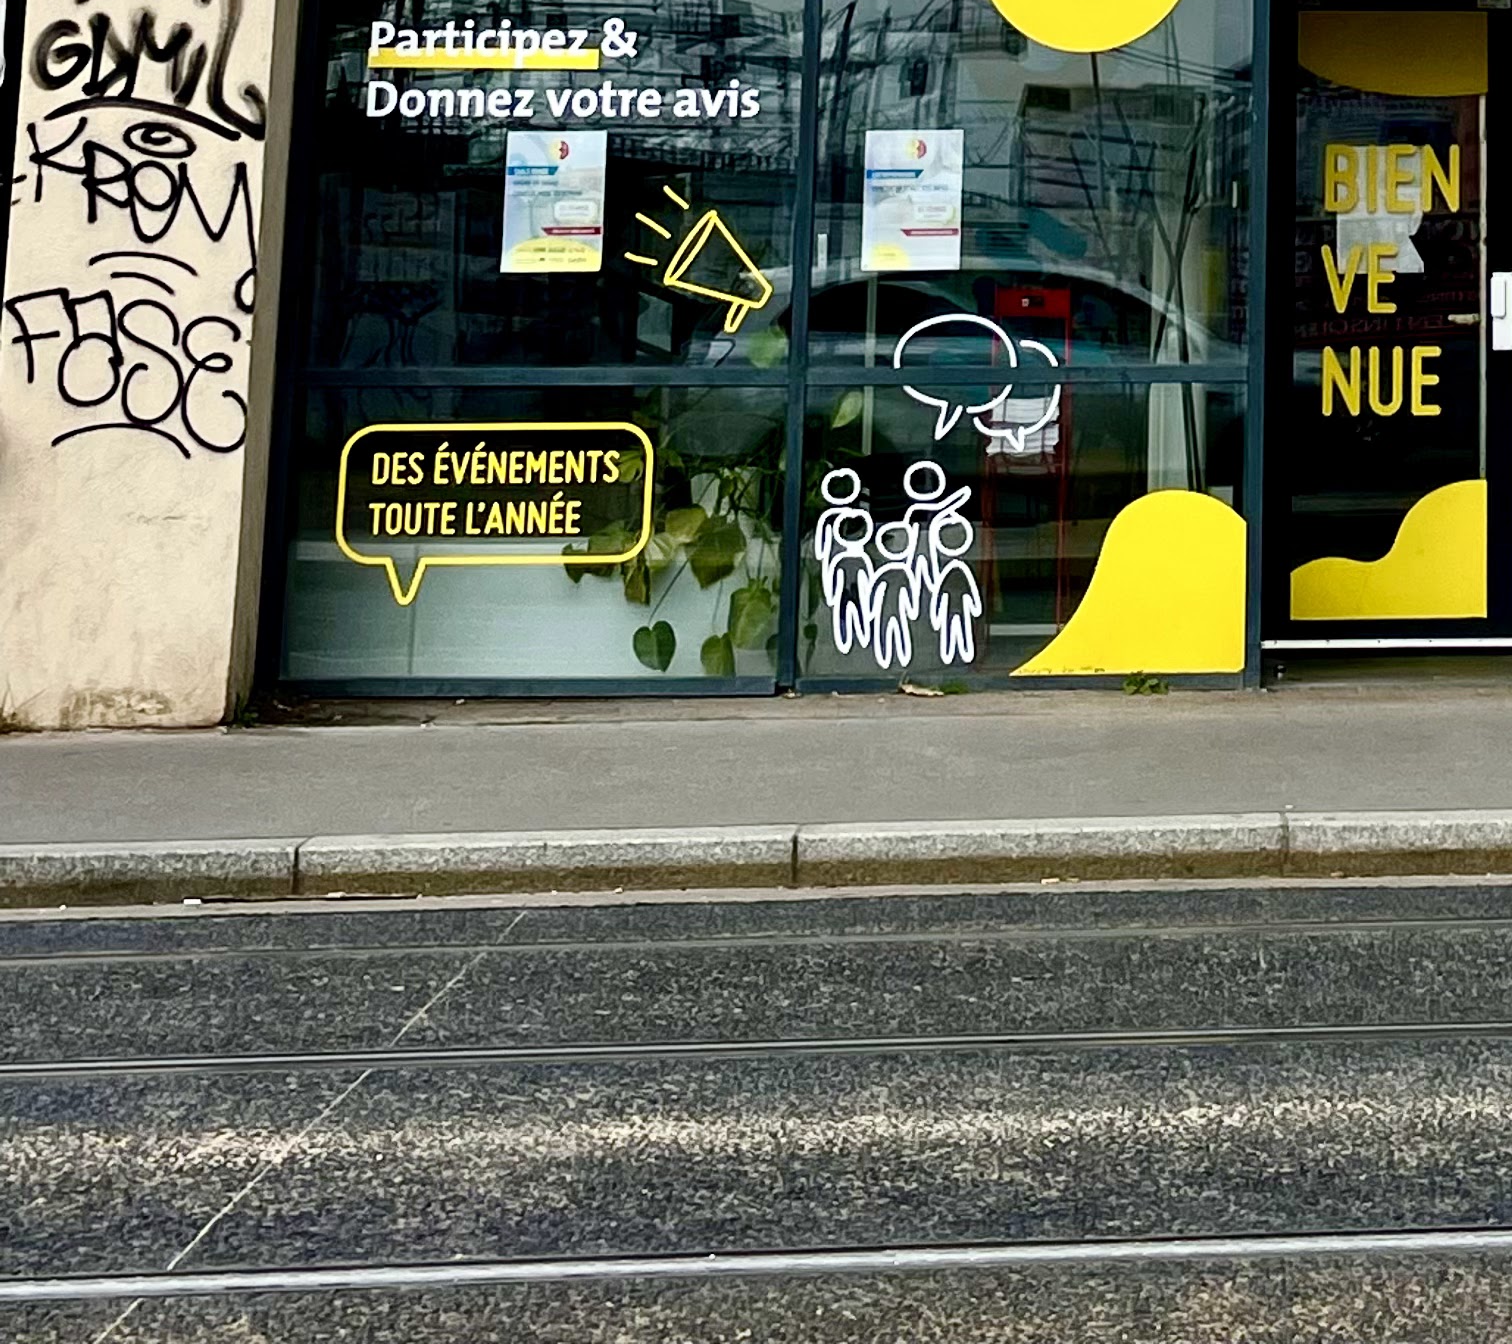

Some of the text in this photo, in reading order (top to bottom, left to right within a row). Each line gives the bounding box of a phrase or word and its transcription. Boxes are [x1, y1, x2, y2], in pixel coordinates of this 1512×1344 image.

[368, 17, 638, 70] Participez &
[366, 78, 760, 119] Donnez votre avis
[1324, 142, 1461, 215] BIEN
[1321, 242, 1398, 315] VE
[1321, 345, 1443, 417] NUE
[370, 442, 620, 486] DES ÉVÉNEMENTS
[368, 494, 582, 537] TOUTE L'ANNÉE
